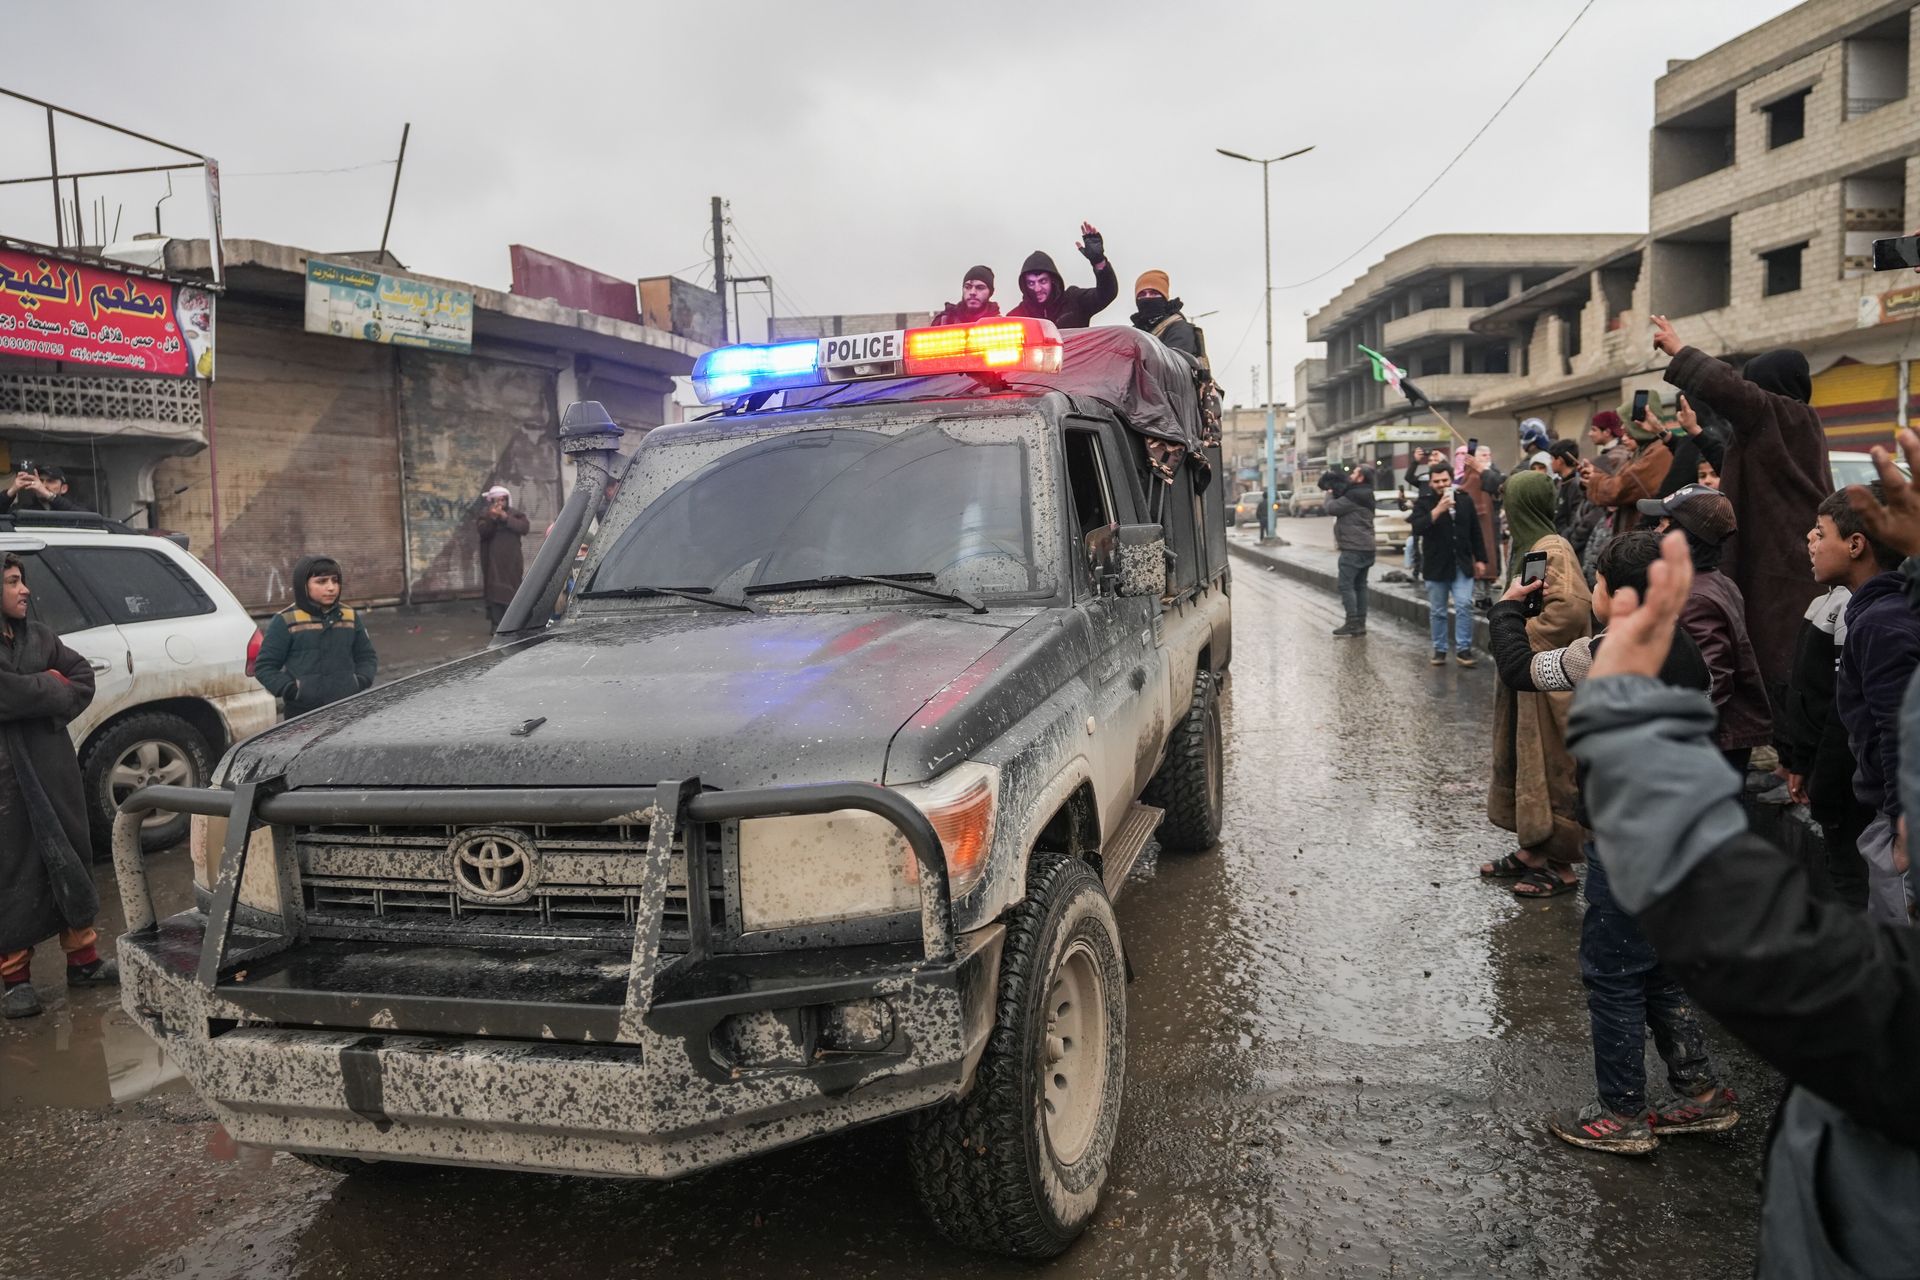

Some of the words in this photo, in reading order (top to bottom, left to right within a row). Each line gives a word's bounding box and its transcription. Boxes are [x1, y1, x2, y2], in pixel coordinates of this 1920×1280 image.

[89, 278, 167, 321] مطعم
[380, 280, 429, 317] يوسف
[425, 287, 470, 319] مركز
[25, 312, 61, 336] مسبحة
[98, 325, 123, 344] فلافل
[131, 336, 154, 348] حمص
[163, 336, 180, 352] فول
[826, 335, 894, 362] POLICE
